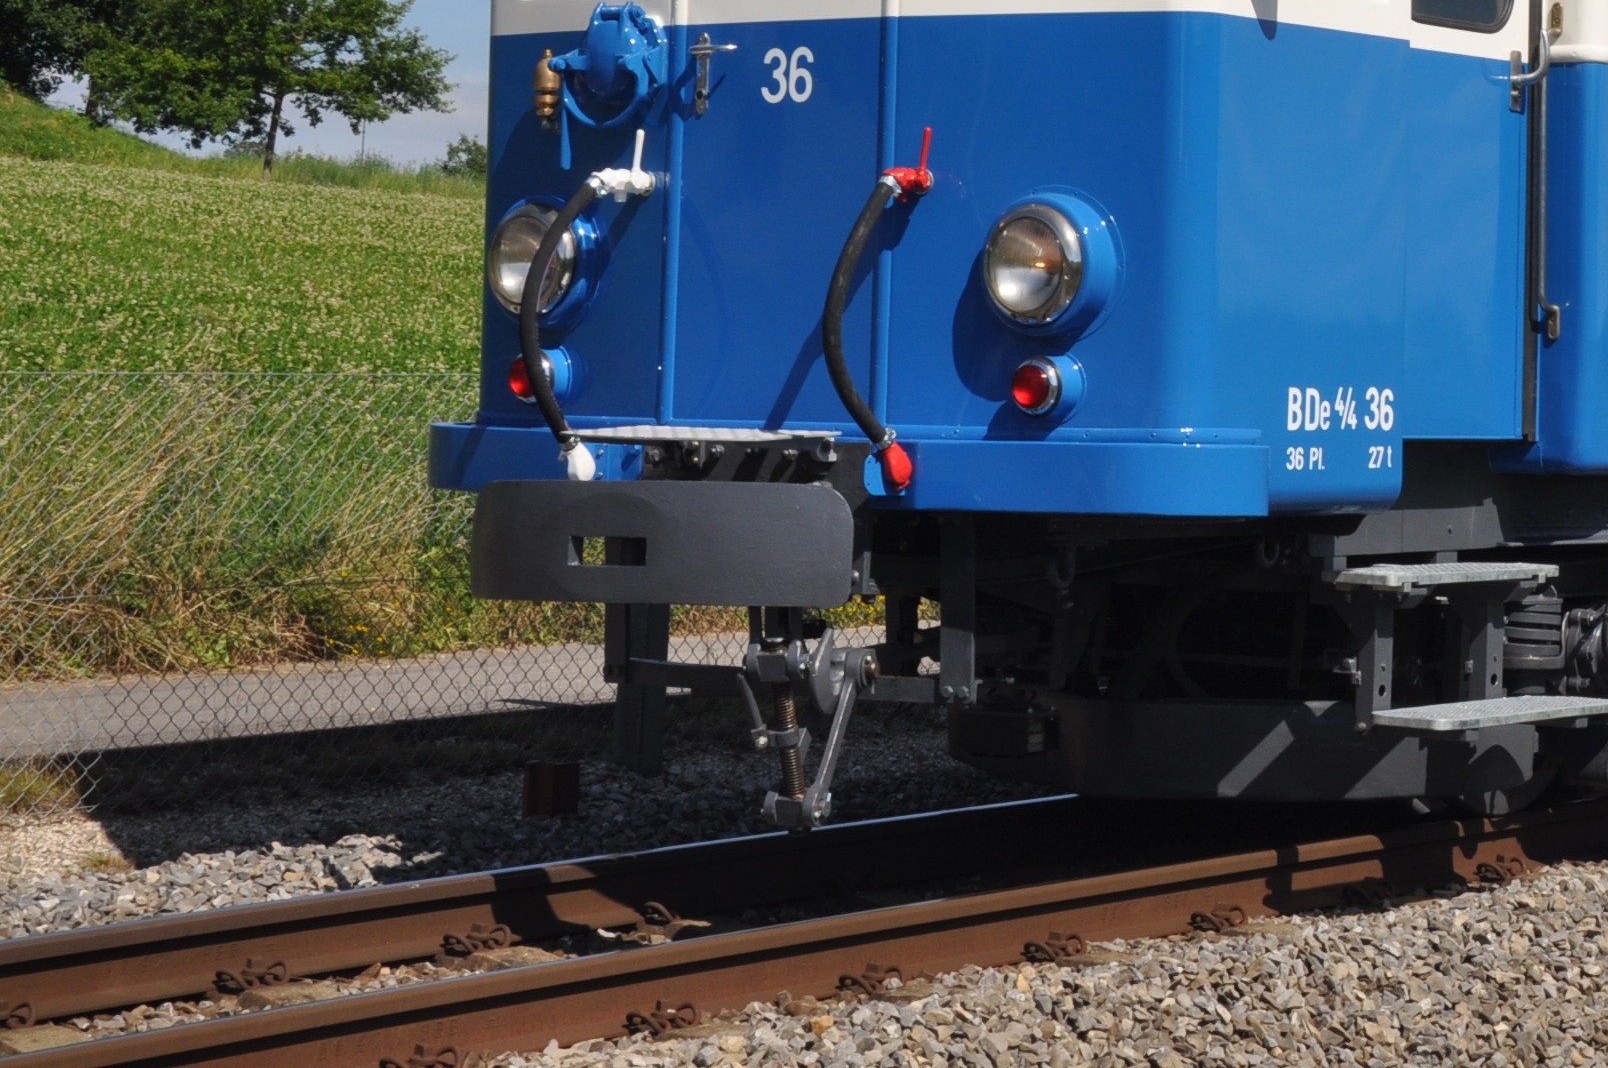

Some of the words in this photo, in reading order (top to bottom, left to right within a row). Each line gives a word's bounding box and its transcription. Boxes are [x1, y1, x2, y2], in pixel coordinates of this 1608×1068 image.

[761, 46, 814, 104] 36
[1286, 386, 1331, 431] BDe
[1364, 386, 1394, 431] 36
[1285, 446, 1305, 471] 36
[1309, 447, 1325, 471] Pl.
[1368, 446, 1385, 469] 27
